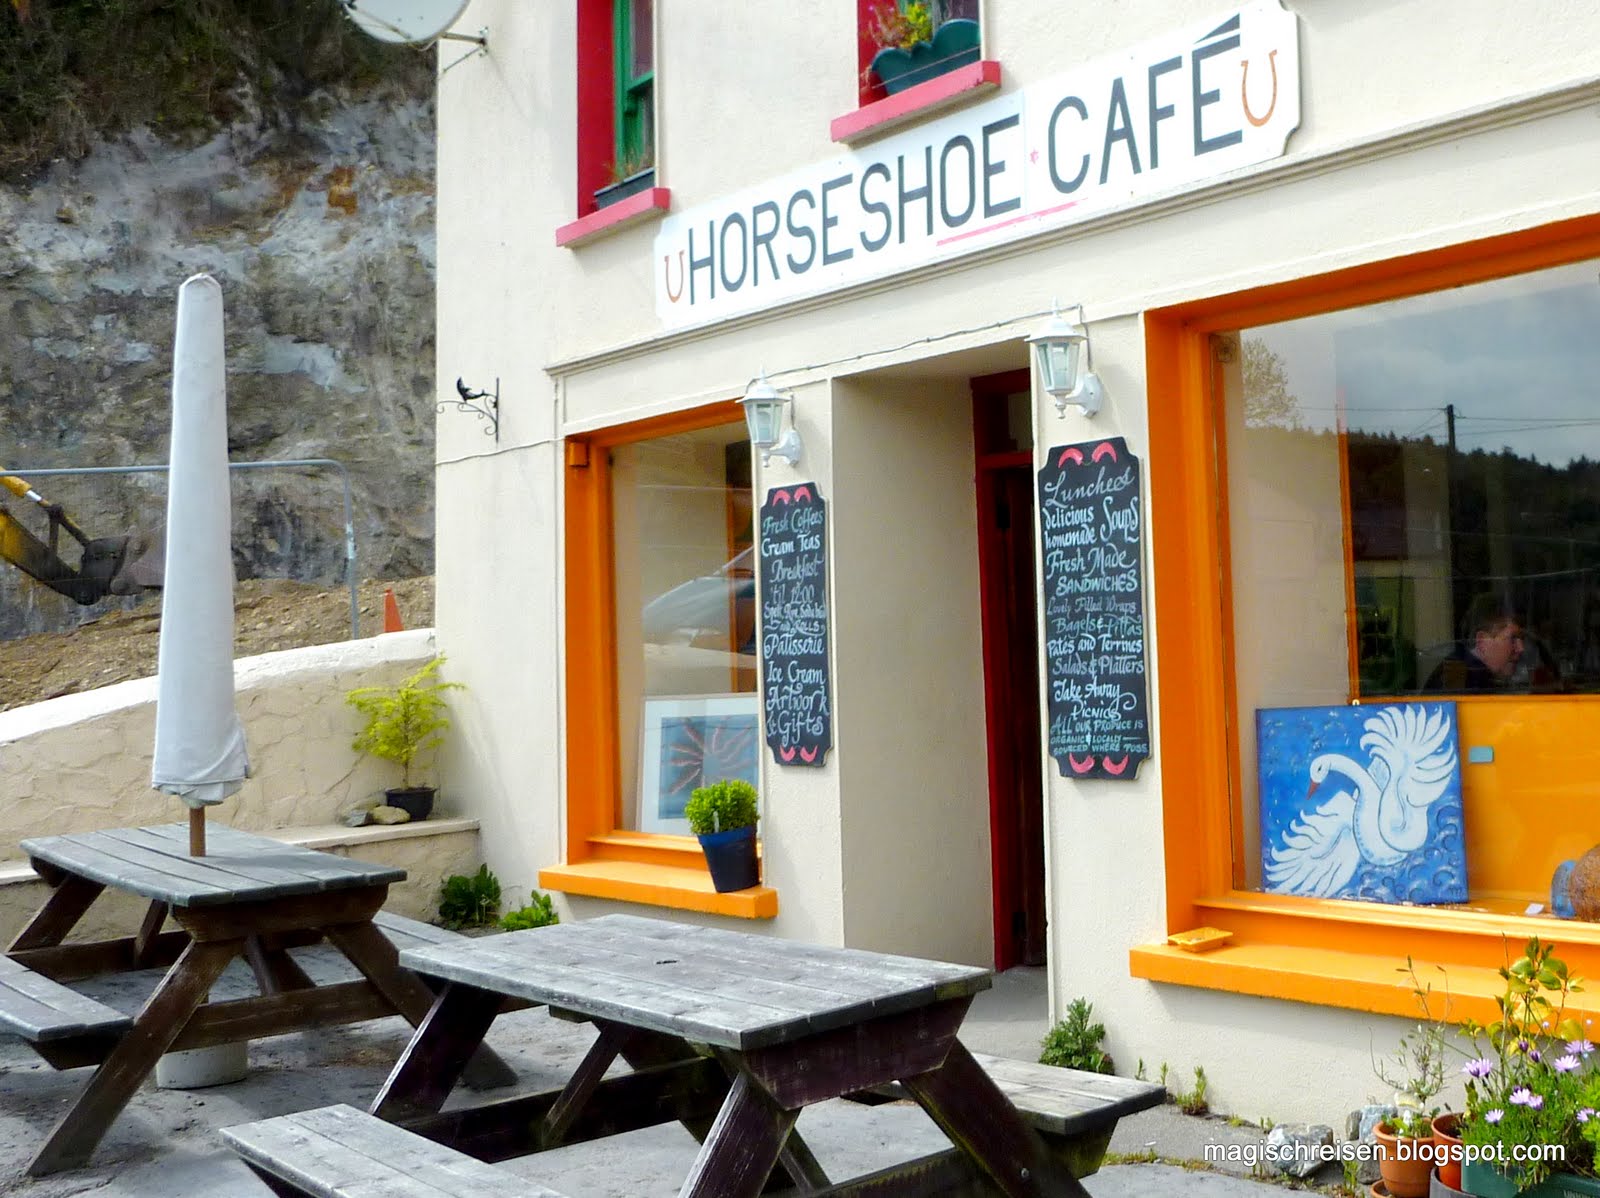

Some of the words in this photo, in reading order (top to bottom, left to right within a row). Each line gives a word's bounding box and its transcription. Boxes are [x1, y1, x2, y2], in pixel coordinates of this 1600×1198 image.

[689, 113, 1021, 305] HORSESHOE
[1048, 13, 1243, 194] CAFÉ
[762, 512, 789, 536] Fresh
[791, 507, 824, 533] Coffees
[1042, 506, 1094, 530] delicious
[1100, 496, 1139, 543] Soups
[762, 538, 795, 557] Cream
[797, 531, 820, 552] Teas
[1044, 524, 1097, 550] homemade
[769, 553, 824, 584] Breakfast
[1046, 547, 1086, 579] Fresh
[1082, 543, 1136, 577] Made
[1056, 569, 1138, 596] SANDWICHES
[1052, 613, 1096, 639] Bagels
[764, 630, 825, 659] Patisserie
[767, 661, 783, 683] Ice
[788, 660, 826, 685] Cream
[1052, 652, 1088, 675] Salads
[1088, 653, 1097, 678] &
[1098, 655, 1144, 675] Platters
[766, 683, 830, 716] Artwork
[1053, 678, 1082, 702] Take
[778, 710, 824, 747] Gifts
